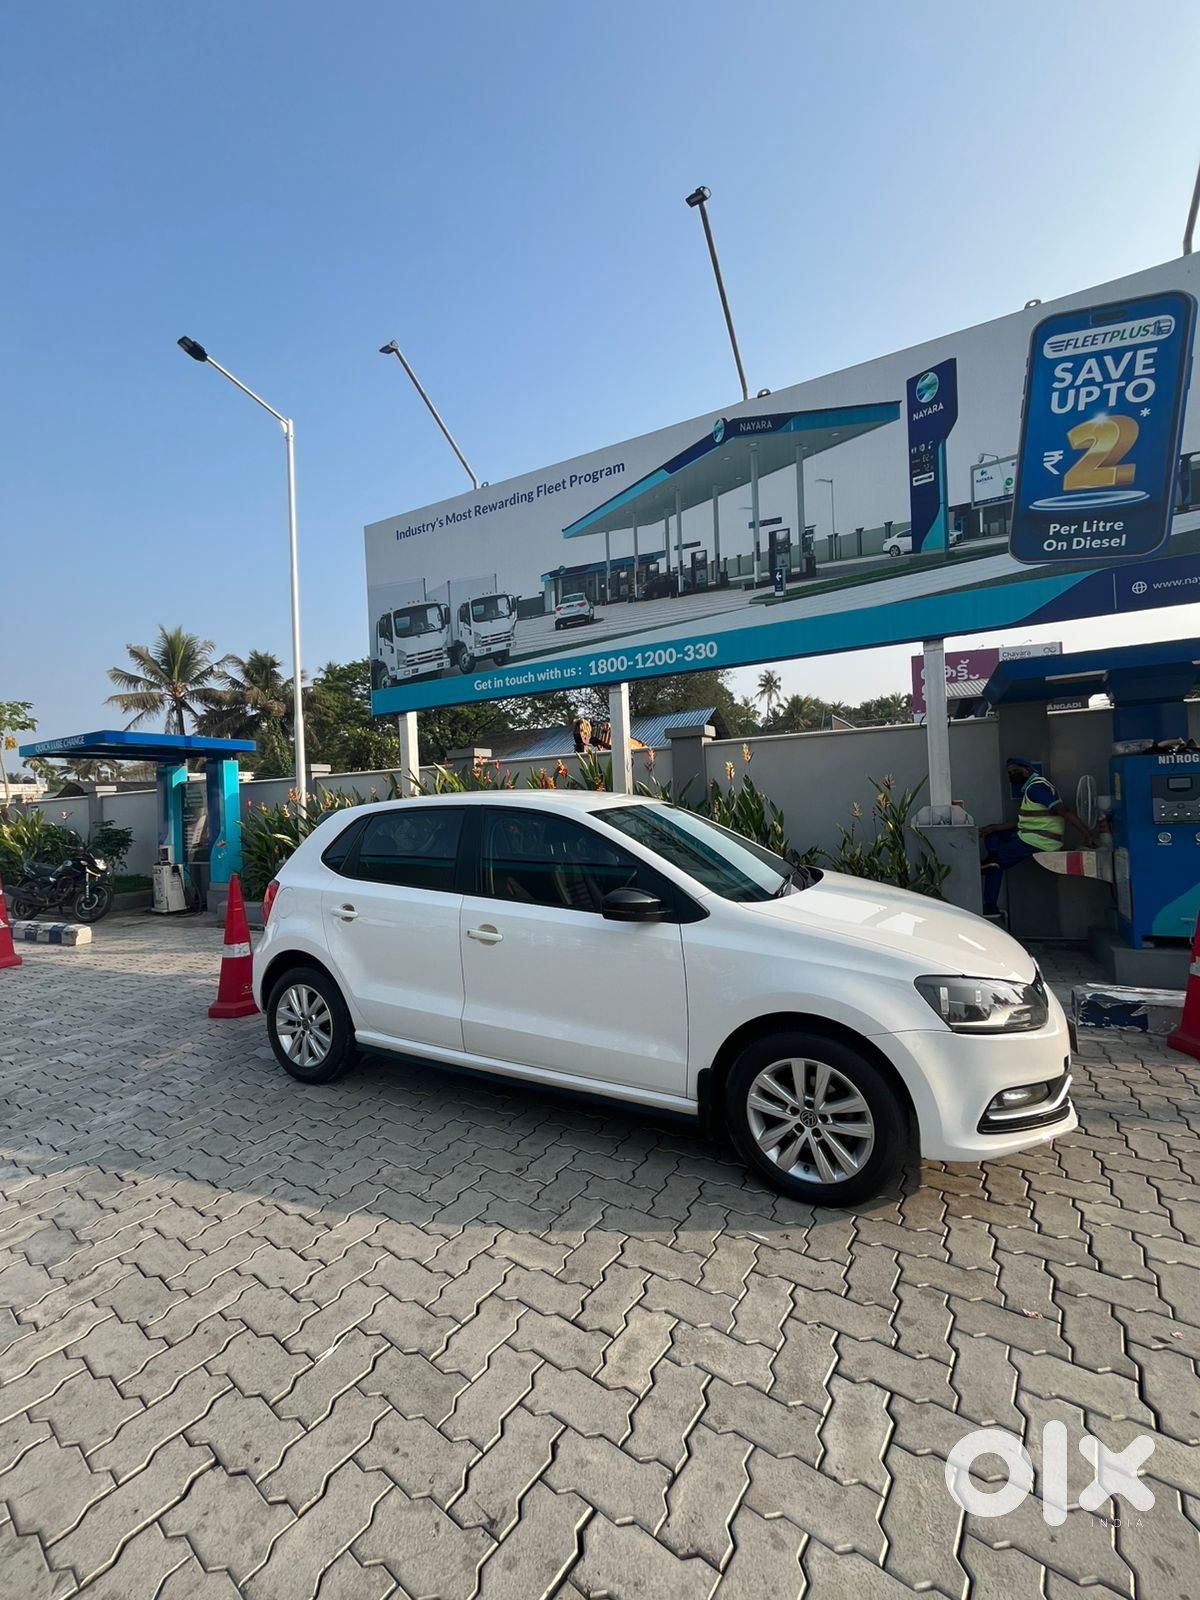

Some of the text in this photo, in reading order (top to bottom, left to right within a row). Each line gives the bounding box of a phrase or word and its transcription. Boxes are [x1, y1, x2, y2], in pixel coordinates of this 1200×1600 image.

[1063, 324, 1153, 352] FLEETPLUS
[1052, 347, 1158, 389] SAVE
[1050, 377, 1156, 415] UPTO
[912, 402, 944, 421] NAYARA
[740, 420, 773, 432] NAYARA
[396, 462, 625, 541] Industry's Most Rewarding Fleet Program
[1049, 520, 1124, 536] Per Litre
[1043, 534, 1127, 552] On Diesel
[1002, 650, 1032, 658] Chavara
[474, 679, 492, 691] Get
[494, 675, 503, 687] in
[506, 670, 535, 687] touch
[538, 667, 562, 681] with
[588, 641, 718, 676] 1800-1200-330
[1047, 702, 1082, 711] ANGADI
[63, 736, 85, 747] CHANGE
[1158, 753, 1200, 765] NITROG
